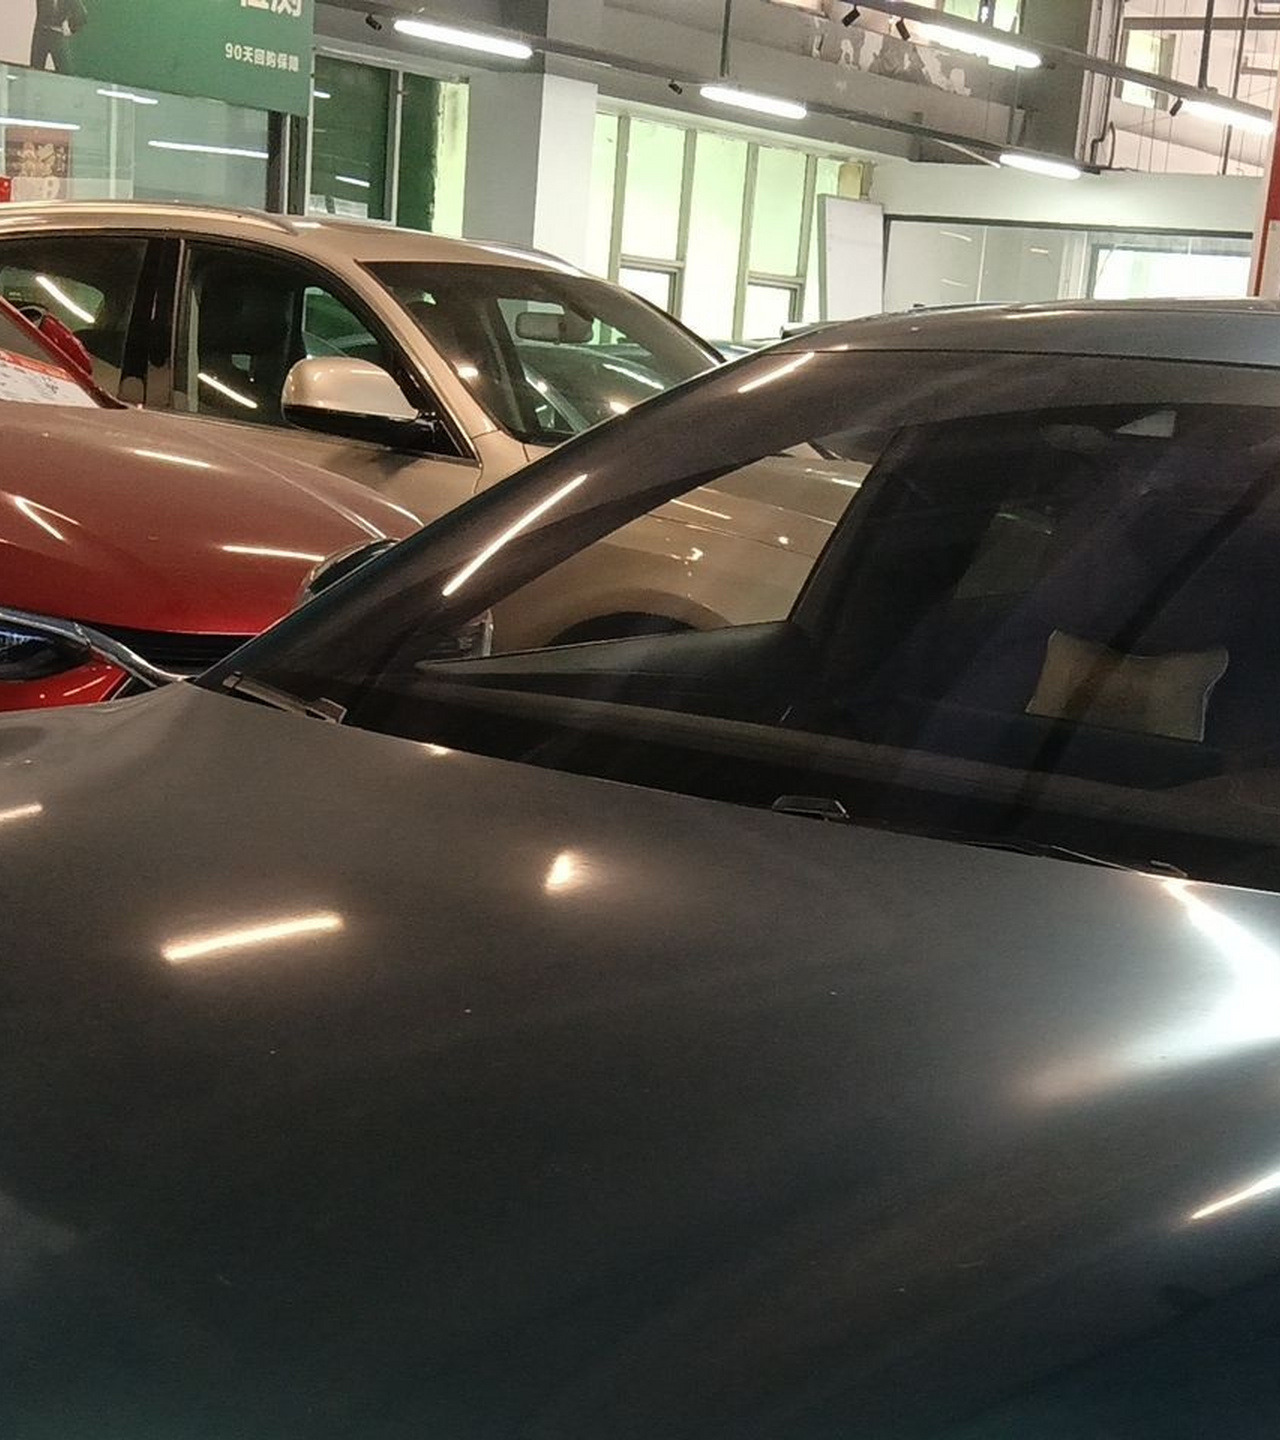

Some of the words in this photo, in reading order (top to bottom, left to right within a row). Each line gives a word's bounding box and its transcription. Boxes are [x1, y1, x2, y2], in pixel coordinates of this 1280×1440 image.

[225, 42, 299, 72] 90天回购保障
